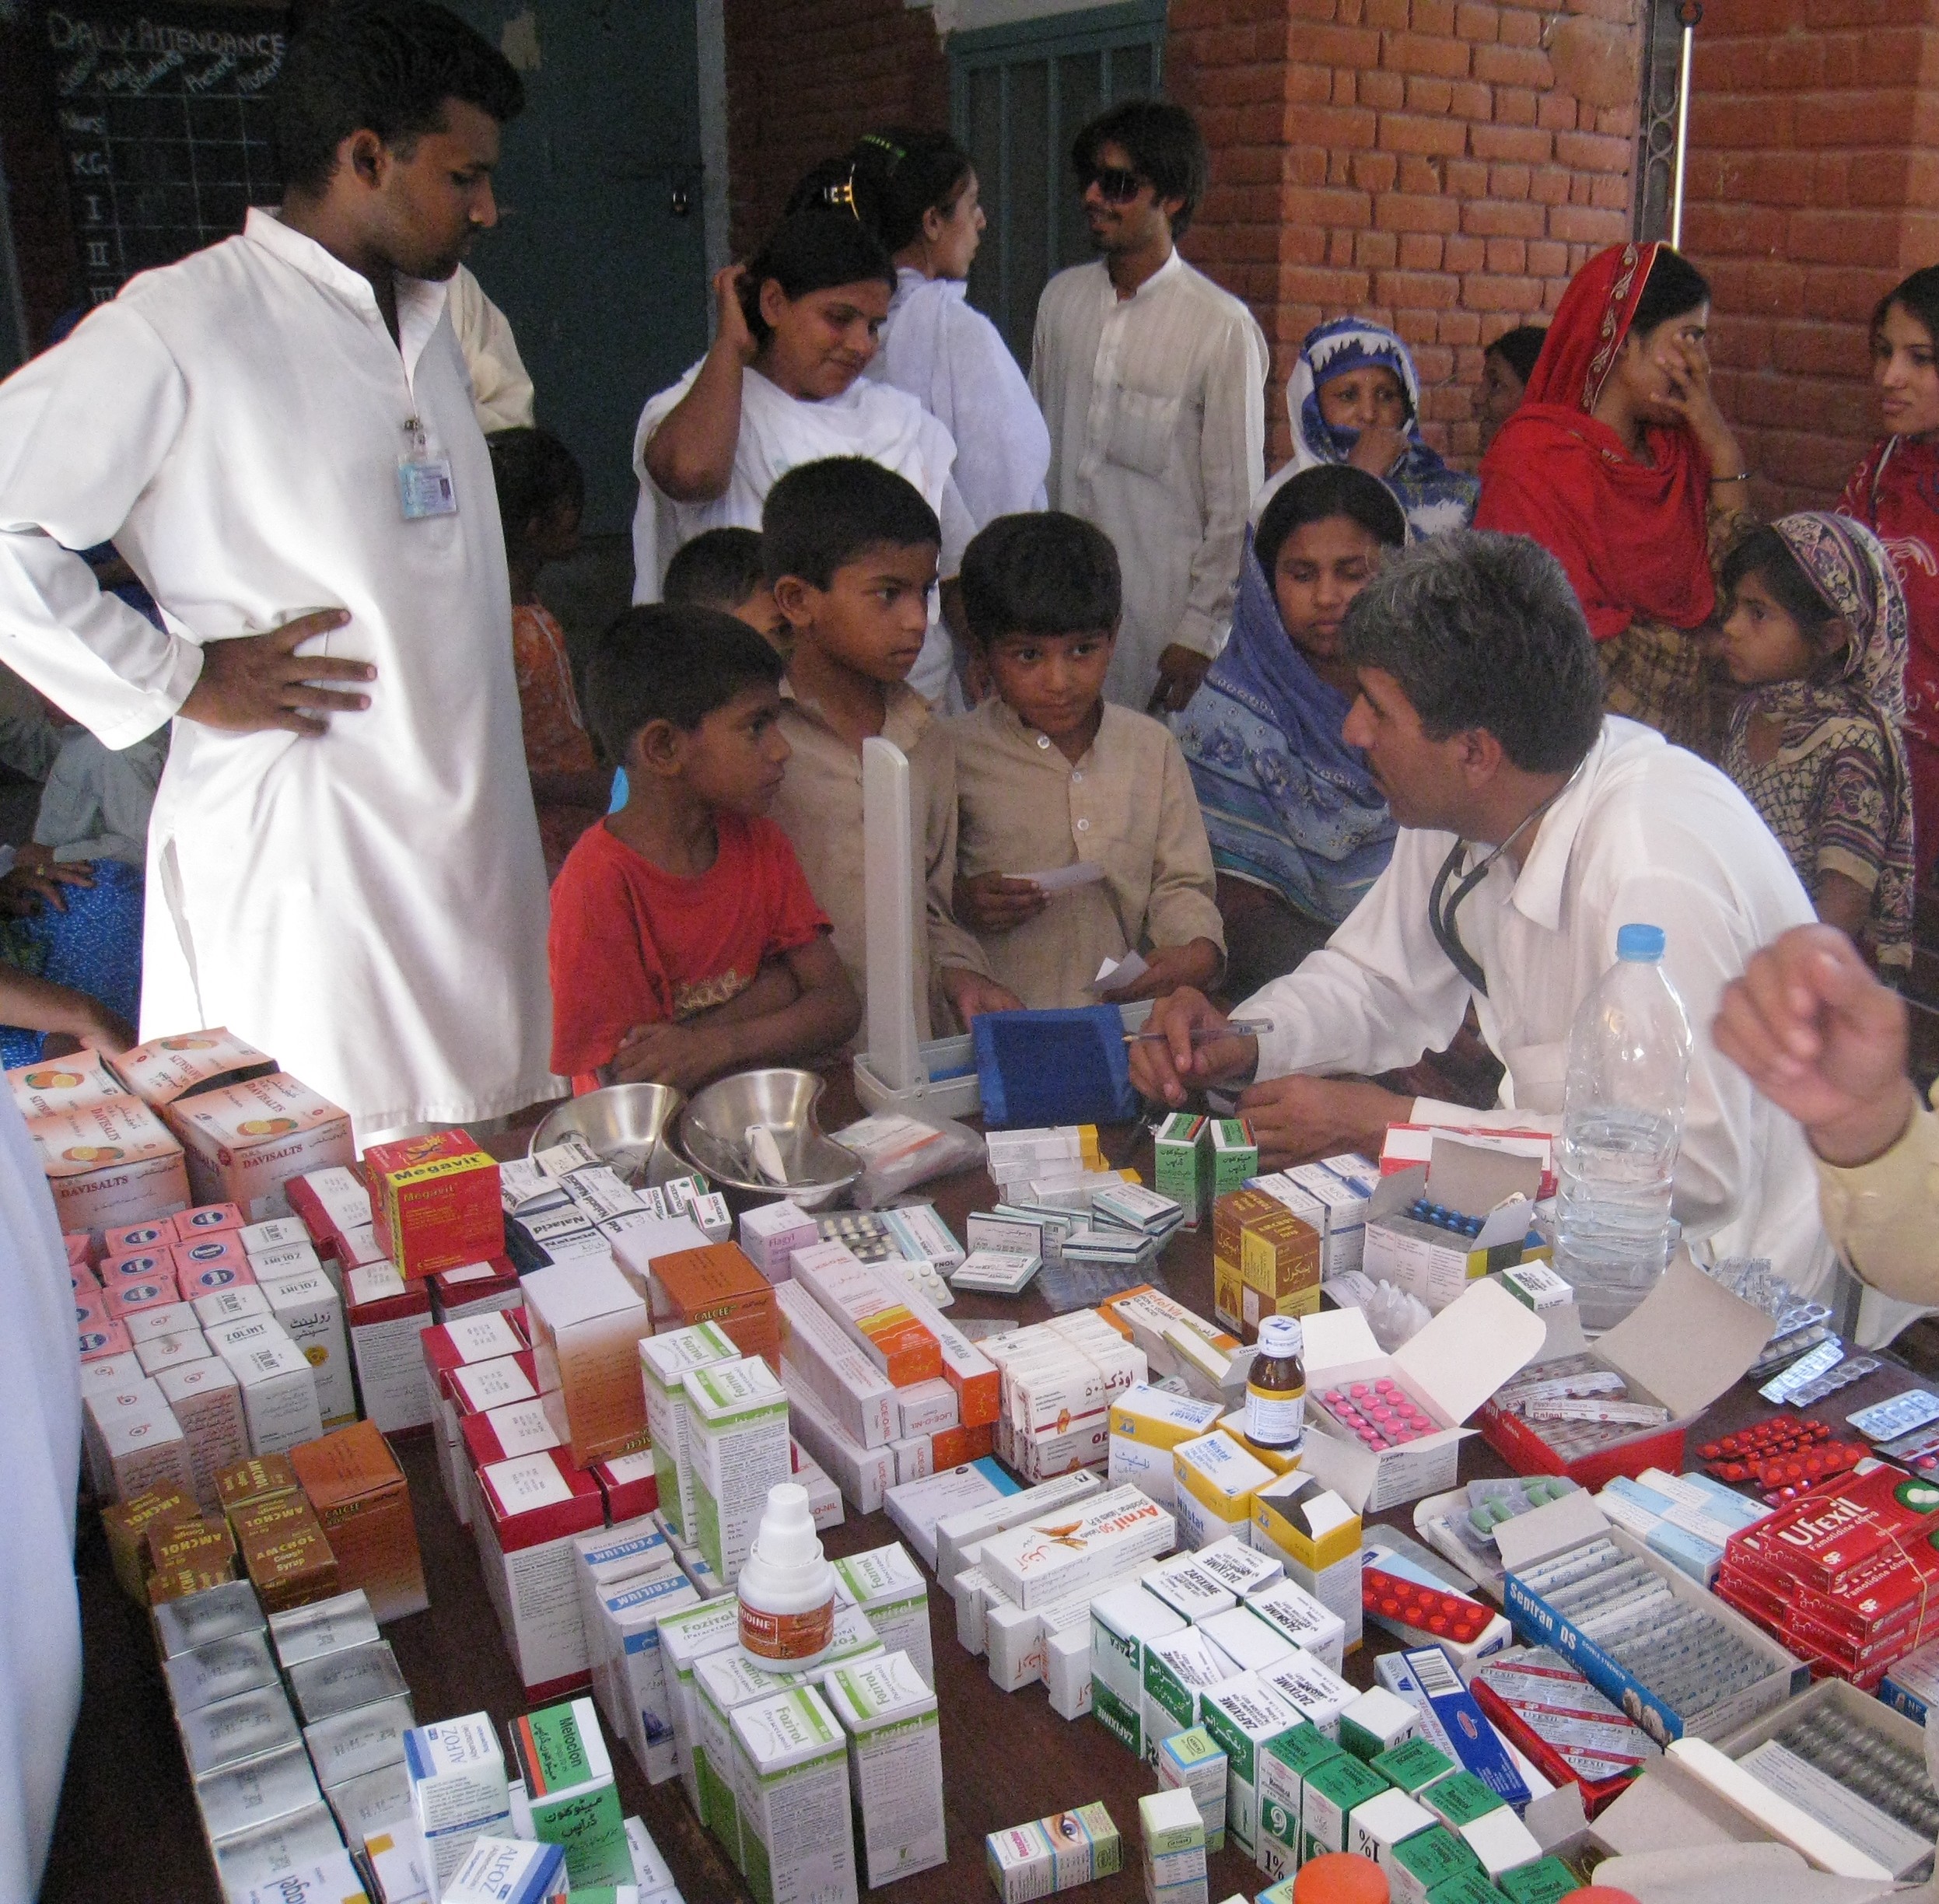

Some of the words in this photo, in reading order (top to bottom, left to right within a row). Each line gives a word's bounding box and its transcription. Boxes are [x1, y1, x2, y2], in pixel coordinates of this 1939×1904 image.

[48, 12, 135, 51] DAILY
[137, 17, 286, 56] ATTENDANCE
[244, 1081, 287, 1113] DAVISALTS
[90, 1106, 121, 1142] DAVISALTS
[243, 1143, 303, 1168] DAVISALTS
[393, 1154, 481, 1181] Megavit
[60, 1175, 129, 1200] DAVISALTS
[404, 1184, 455, 1202] Megavit
[533, 1215, 586, 1235] Nalacid
[768, 1233, 796, 1248] Flagyl
[880, 1398, 891, 1440] LICE-O-NIL
[910, 1411, 953, 1429] LICE-O-NIL
[1170, 1411, 1202, 1424] Nilstat
[1206, 1439, 1232, 1462] Nilstat
[245, 1506, 304, 1528] AMCHOL
[1097, 1522, 1115, 1535] 50
[1114, 1506, 1160, 1535] Arnil
[160, 1533, 222, 1557] AMCHOL
[257, 1535, 316, 1561] AMCHOL
[1808, 1518, 1856, 1552] Famotidine
[594, 1536, 655, 1561] PERILIUM
[276, 1557, 306, 1573] Syrup
[1202, 1556, 1242, 1584] ZAFIXIME
[617, 1579, 680, 1605] PERILIUM
[1183, 1568, 1223, 1596] ZAFIXIME
[1843, 1570, 1891, 1599] Famotidine
[1509, 1581, 1554, 1633] Sentran
[1559, 1624, 1577, 1650] DS
[1272, 1675, 1316, 1707] ZAFIXIME
[1218, 1696, 1258, 1731] ZAFIXIME
[1418, 1697, 1434, 1723] COVERS
[441, 1726, 468, 1763] ALFOZ
[559, 1716, 583, 1767] Metoclon
[480, 1844, 519, 1895] ALFOZ
